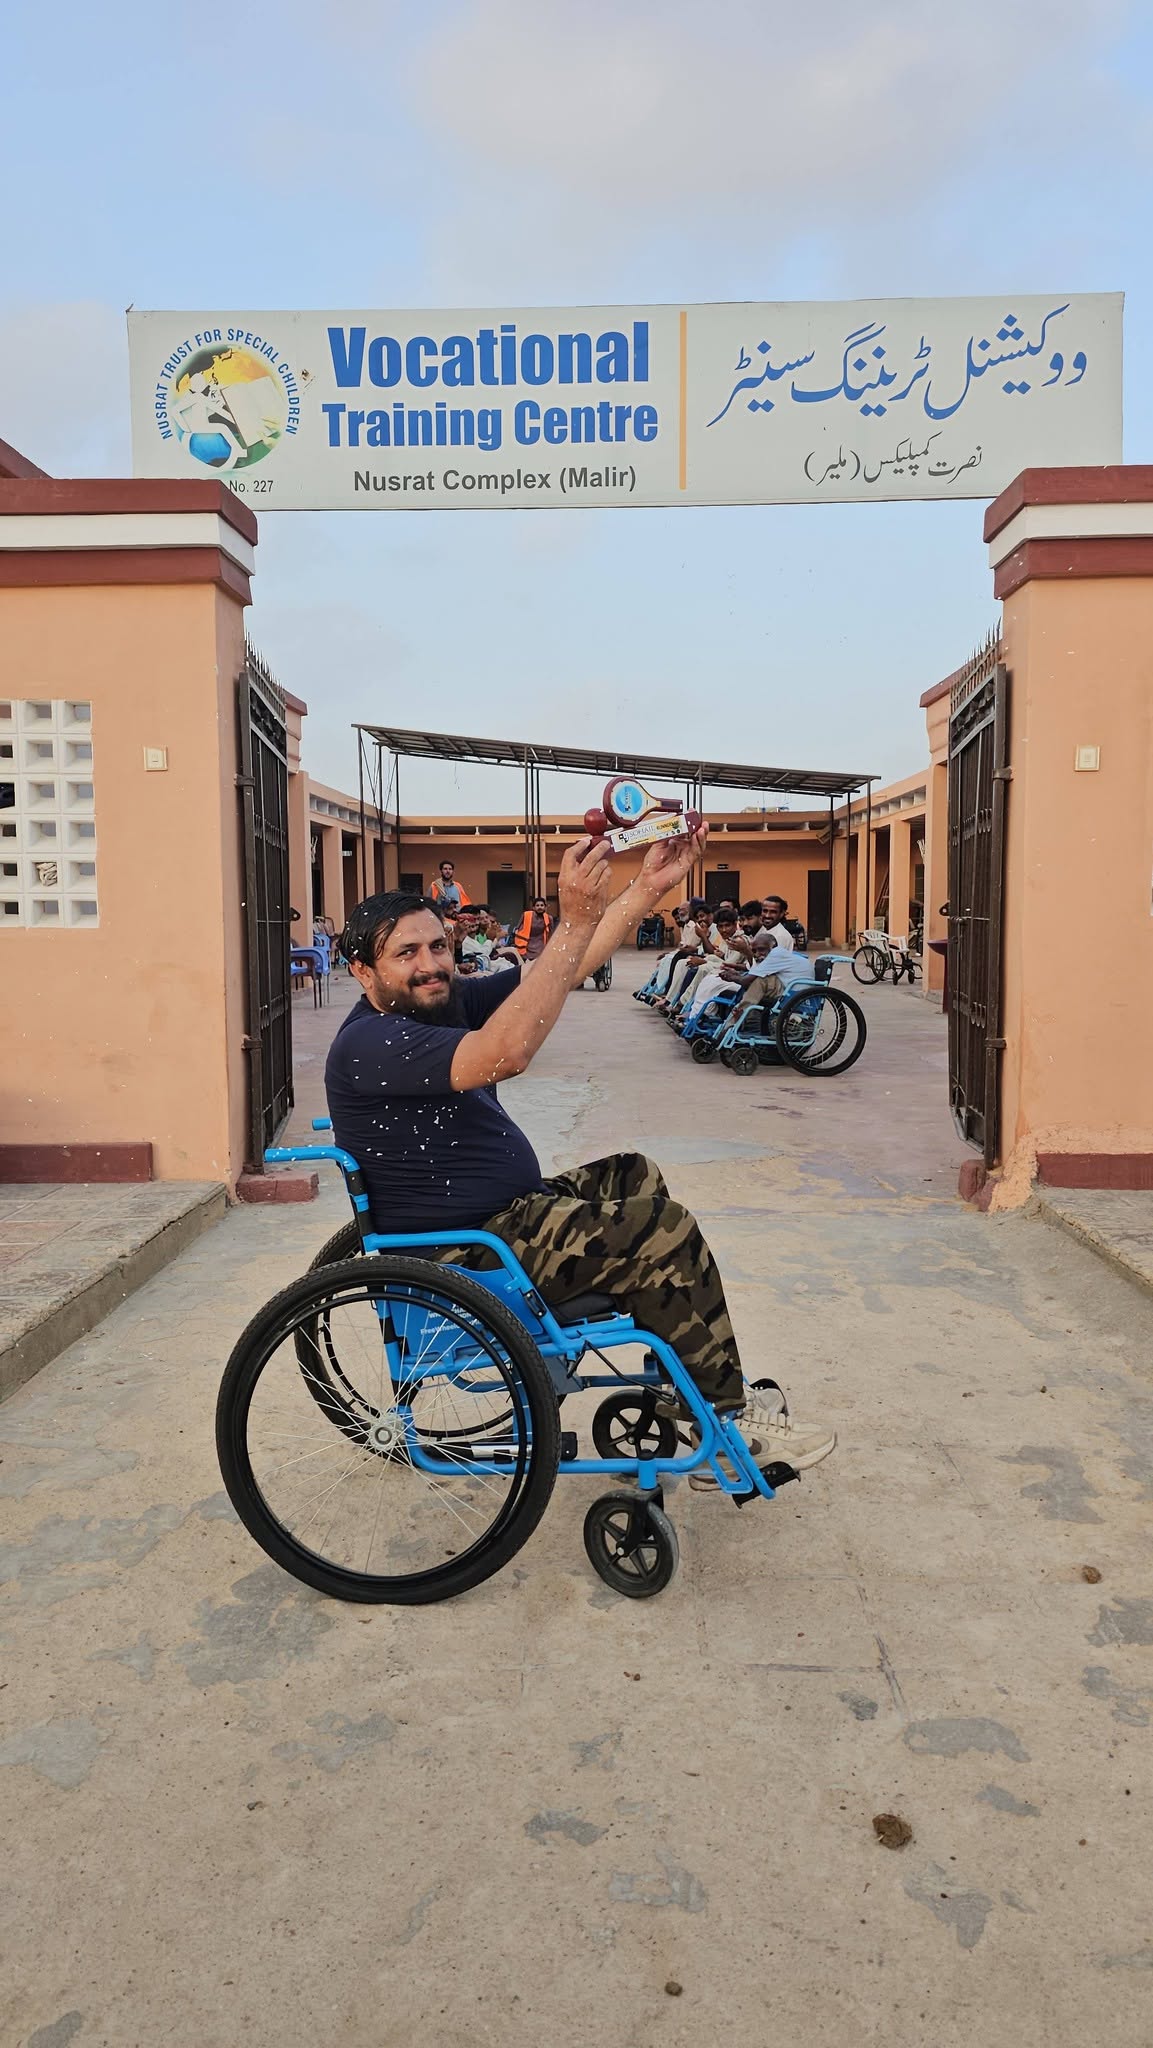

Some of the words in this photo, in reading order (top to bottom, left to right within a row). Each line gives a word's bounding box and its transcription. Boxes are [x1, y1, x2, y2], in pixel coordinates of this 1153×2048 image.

[194, 329, 222, 346] FOR
[227, 328, 279, 364] SPECIAL
[326, 321, 650, 389] Vocational
[160, 340, 193, 379] TRUST
[155, 383, 173, 440] NUSRAT
[278, 363, 301, 435] CHILDREN
[321, 401, 503, 452] Training
[513, 400, 659, 446] Centre
[354, 470, 435, 492] Nusrat
[442, 468, 552, 494] Complex
[559, 465, 637, 493] (Malir)
[803, 446, 861, 486] (ملیر)
[927, 444, 982, 484] نصرت
[229, 480, 249, 492] No.
[253, 480, 274, 492] 227
